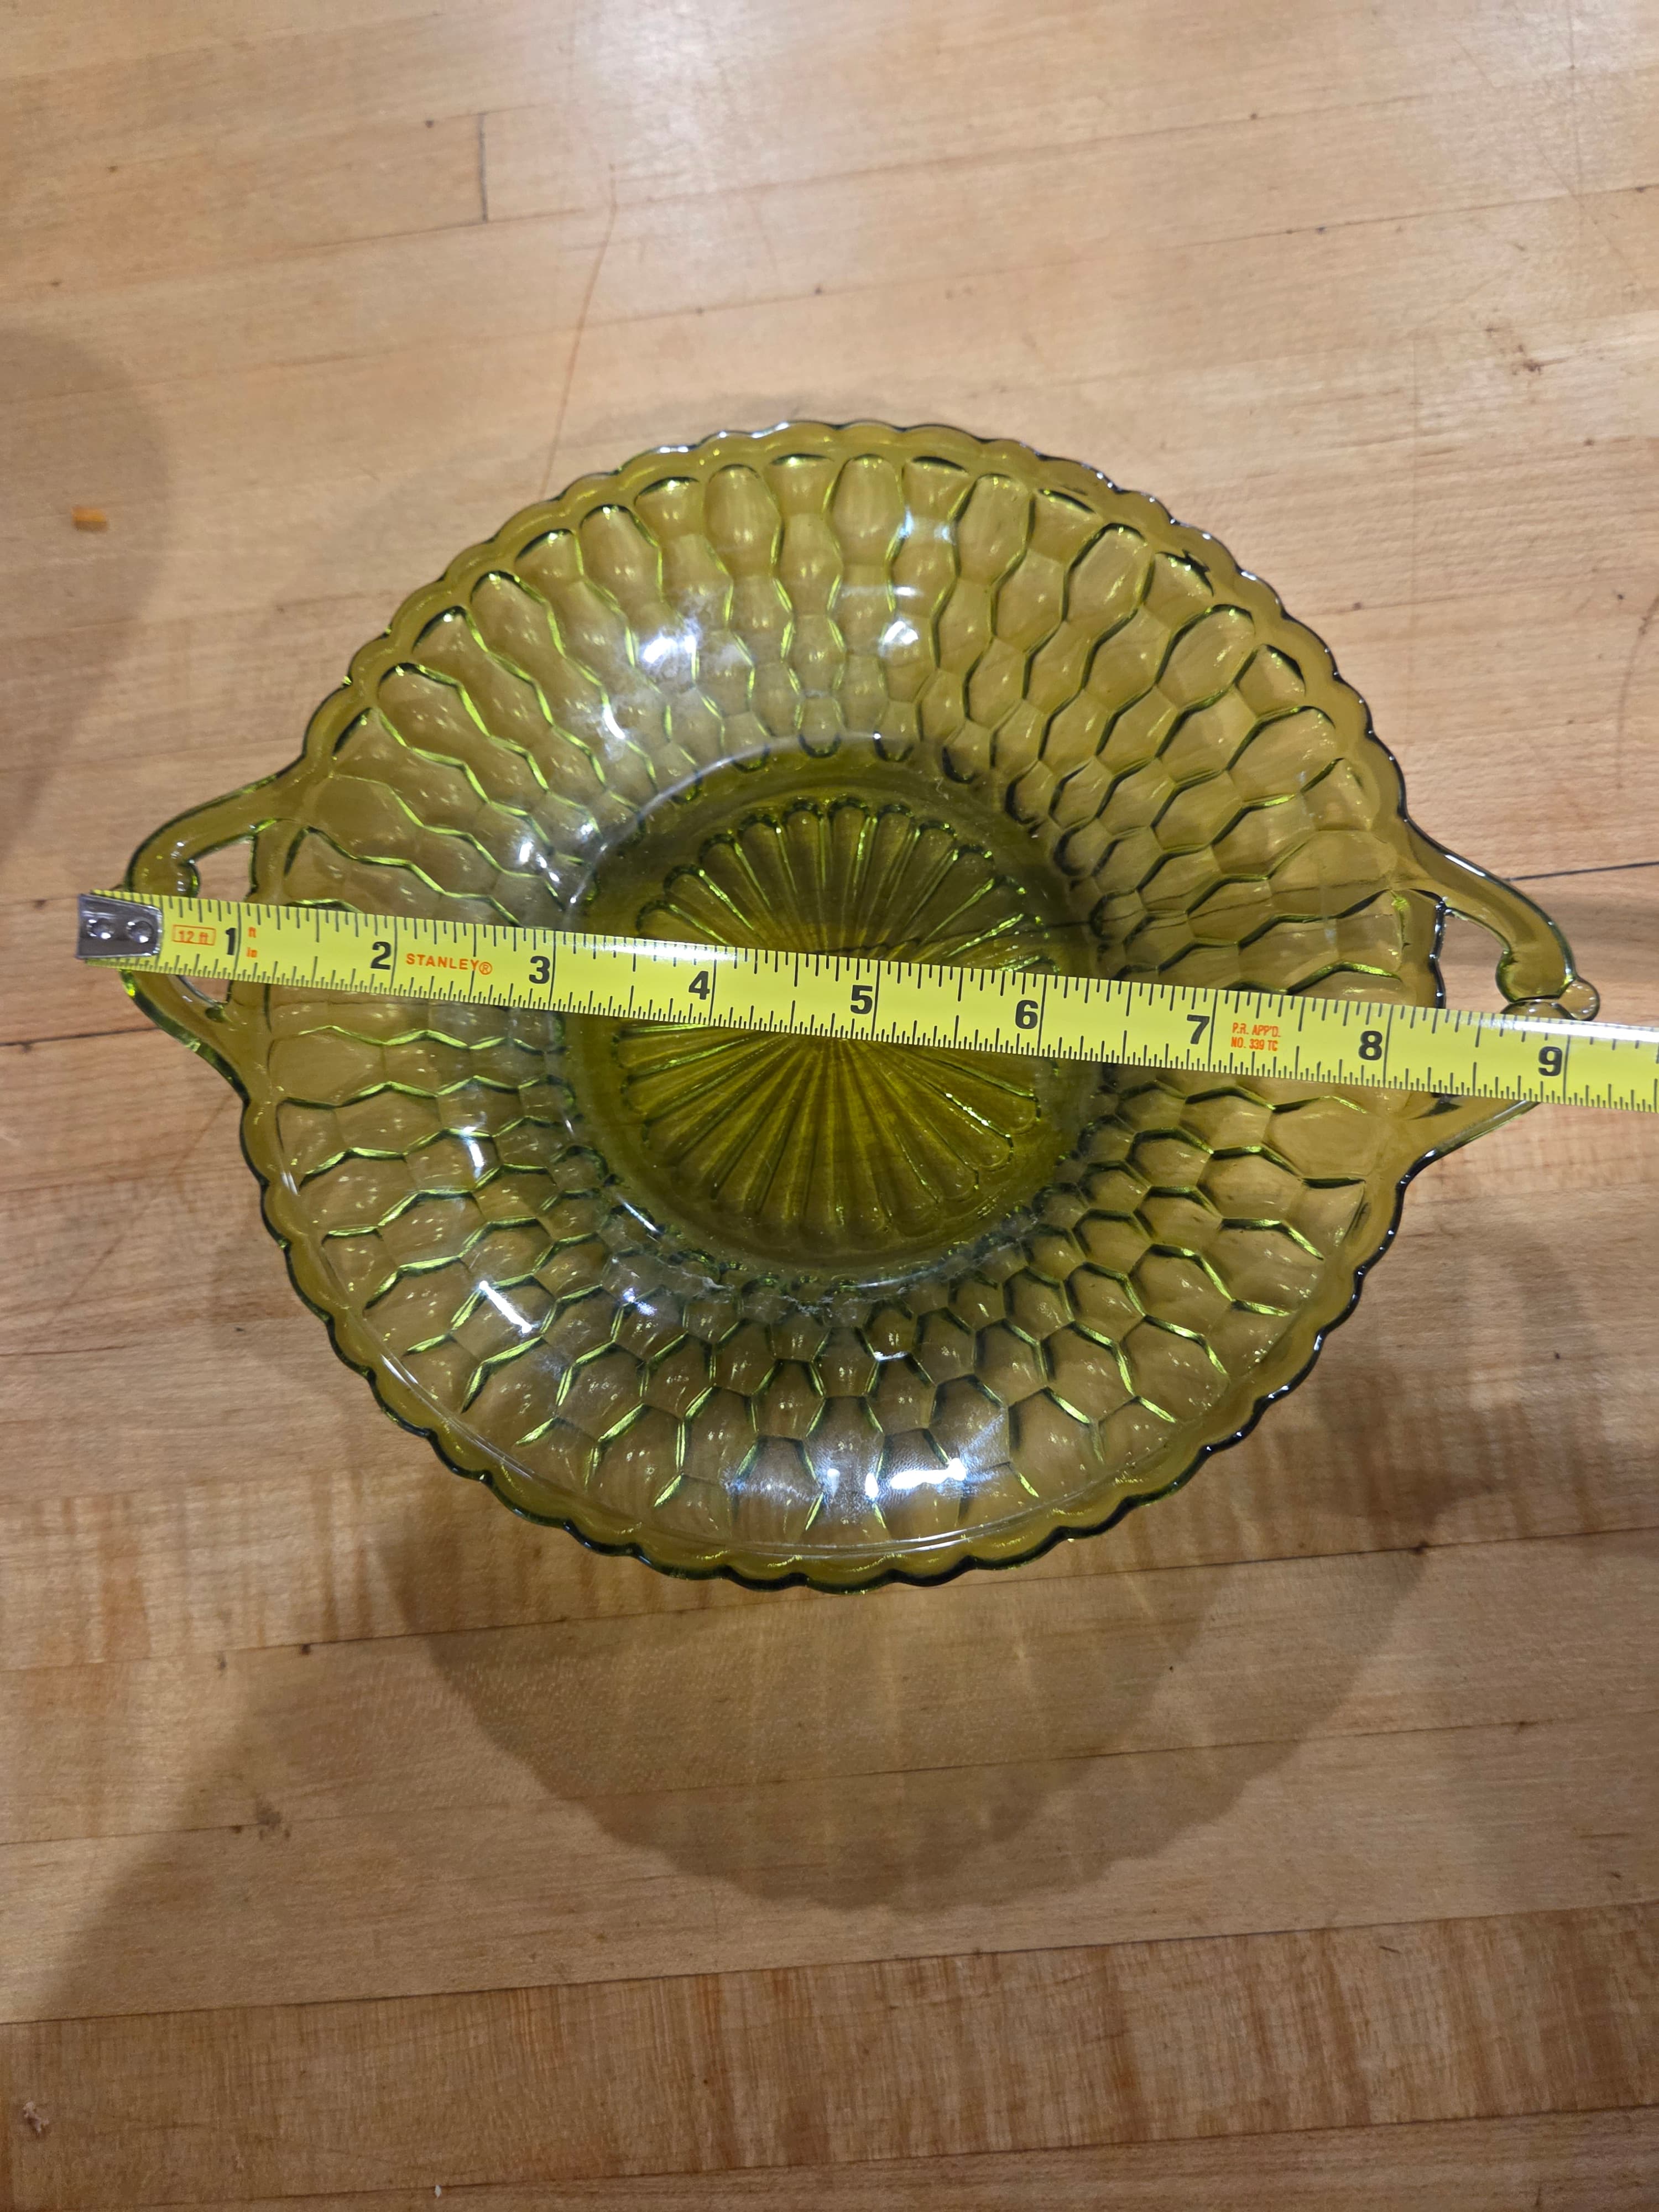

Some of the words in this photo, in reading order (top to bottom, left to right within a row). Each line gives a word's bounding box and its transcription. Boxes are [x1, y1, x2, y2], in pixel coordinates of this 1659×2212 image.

[178, 930, 194, 942] 12
[199, 932, 208, 944] ft
[225, 927, 236, 956] 1
[370, 941, 392, 970] 2
[529, 956, 551, 984] 3
[688, 971, 710, 1000] 4
[850, 984, 873, 1014] 5
[1015, 999, 1039, 1029] 6
[1187, 1014, 1210, 1045] 7
[1358, 1030, 1383, 1061] 8
[1538, 1046, 1563, 1076] 9
[1232, 1022, 1249, 1035] P.R.
[1231, 1036, 1246, 1048] NO.
[1249, 1038, 1265, 1050] 339
[1267, 1040, 1278, 1051] TC
